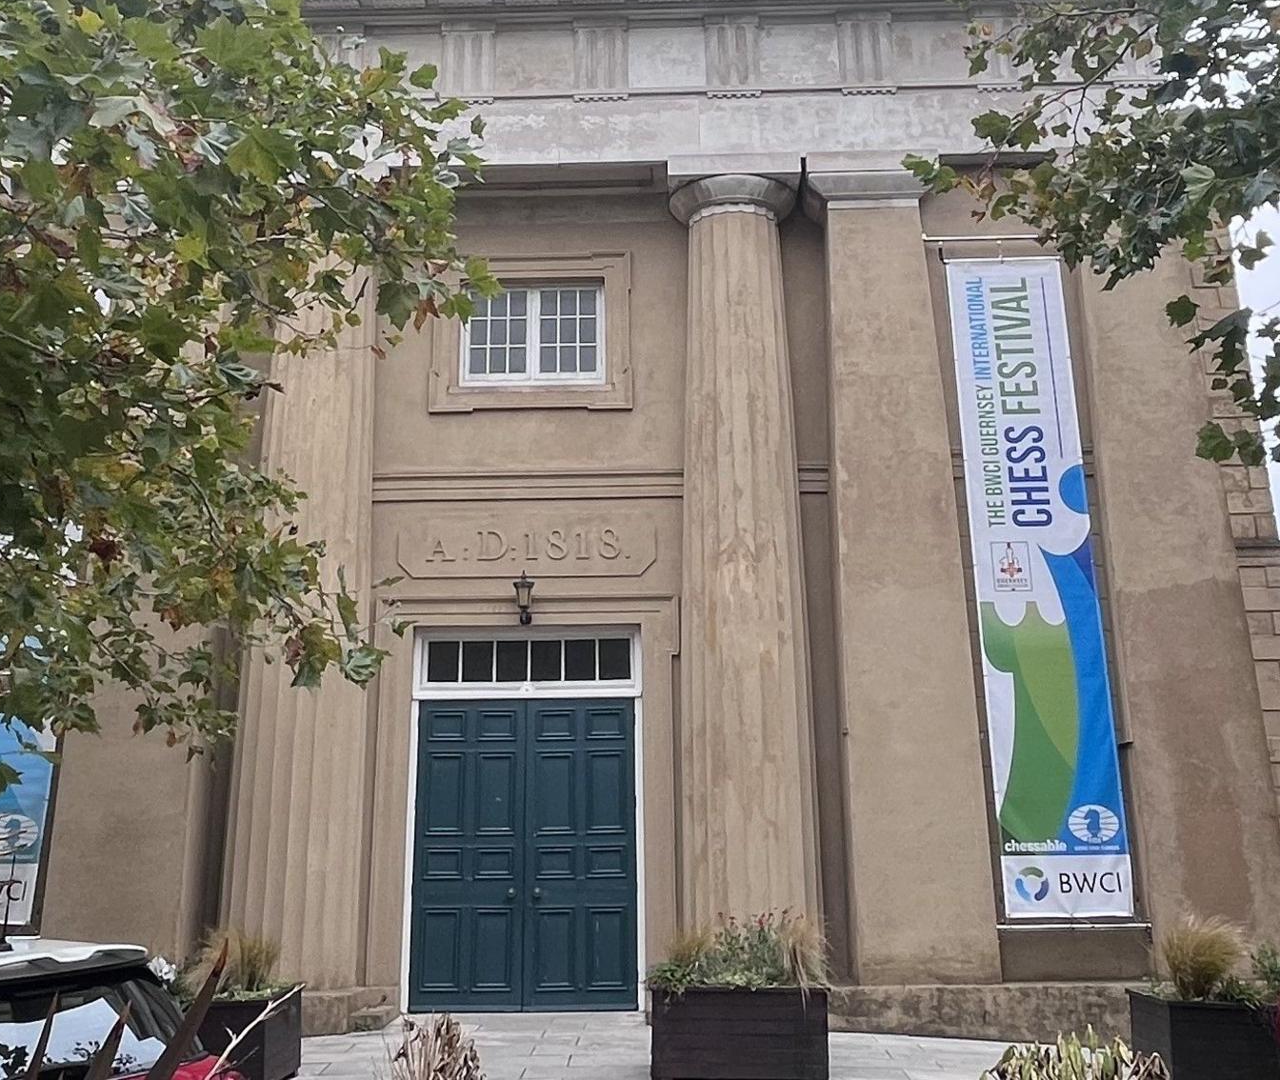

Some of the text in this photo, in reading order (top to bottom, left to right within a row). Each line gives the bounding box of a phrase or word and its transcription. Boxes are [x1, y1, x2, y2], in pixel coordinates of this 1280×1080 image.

[989, 276, 1041, 415] FESTIVAL
[965, 276, 1006, 528] THE BWCI GUERNSEY INTERNATIONAL
[1003, 425, 1053, 528] CHESS
[1004, 839, 1067, 852] chessable
[1059, 872, 1122, 894] BWCI
